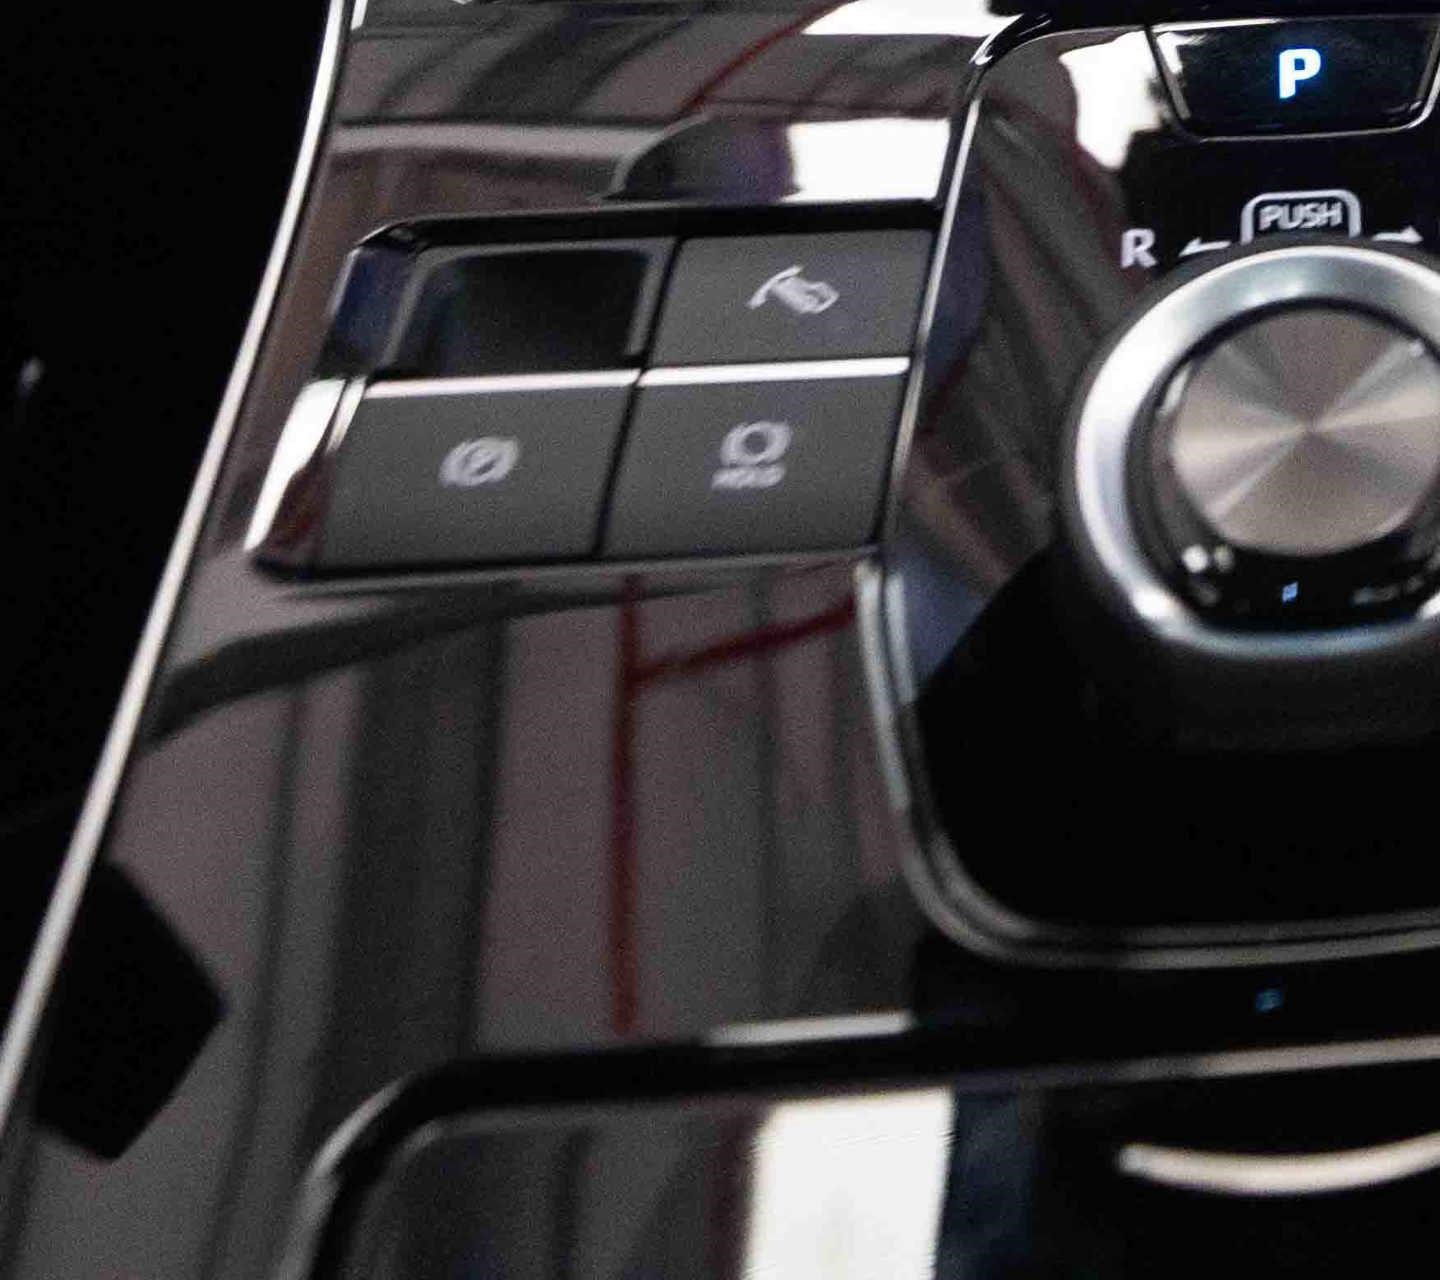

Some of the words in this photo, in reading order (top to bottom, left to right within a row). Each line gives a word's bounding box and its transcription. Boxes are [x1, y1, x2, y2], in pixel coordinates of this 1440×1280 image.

[1278, 46, 1323, 99] P
[1258, 202, 1343, 230] PUSH
[1121, 229, 1156, 268] R
